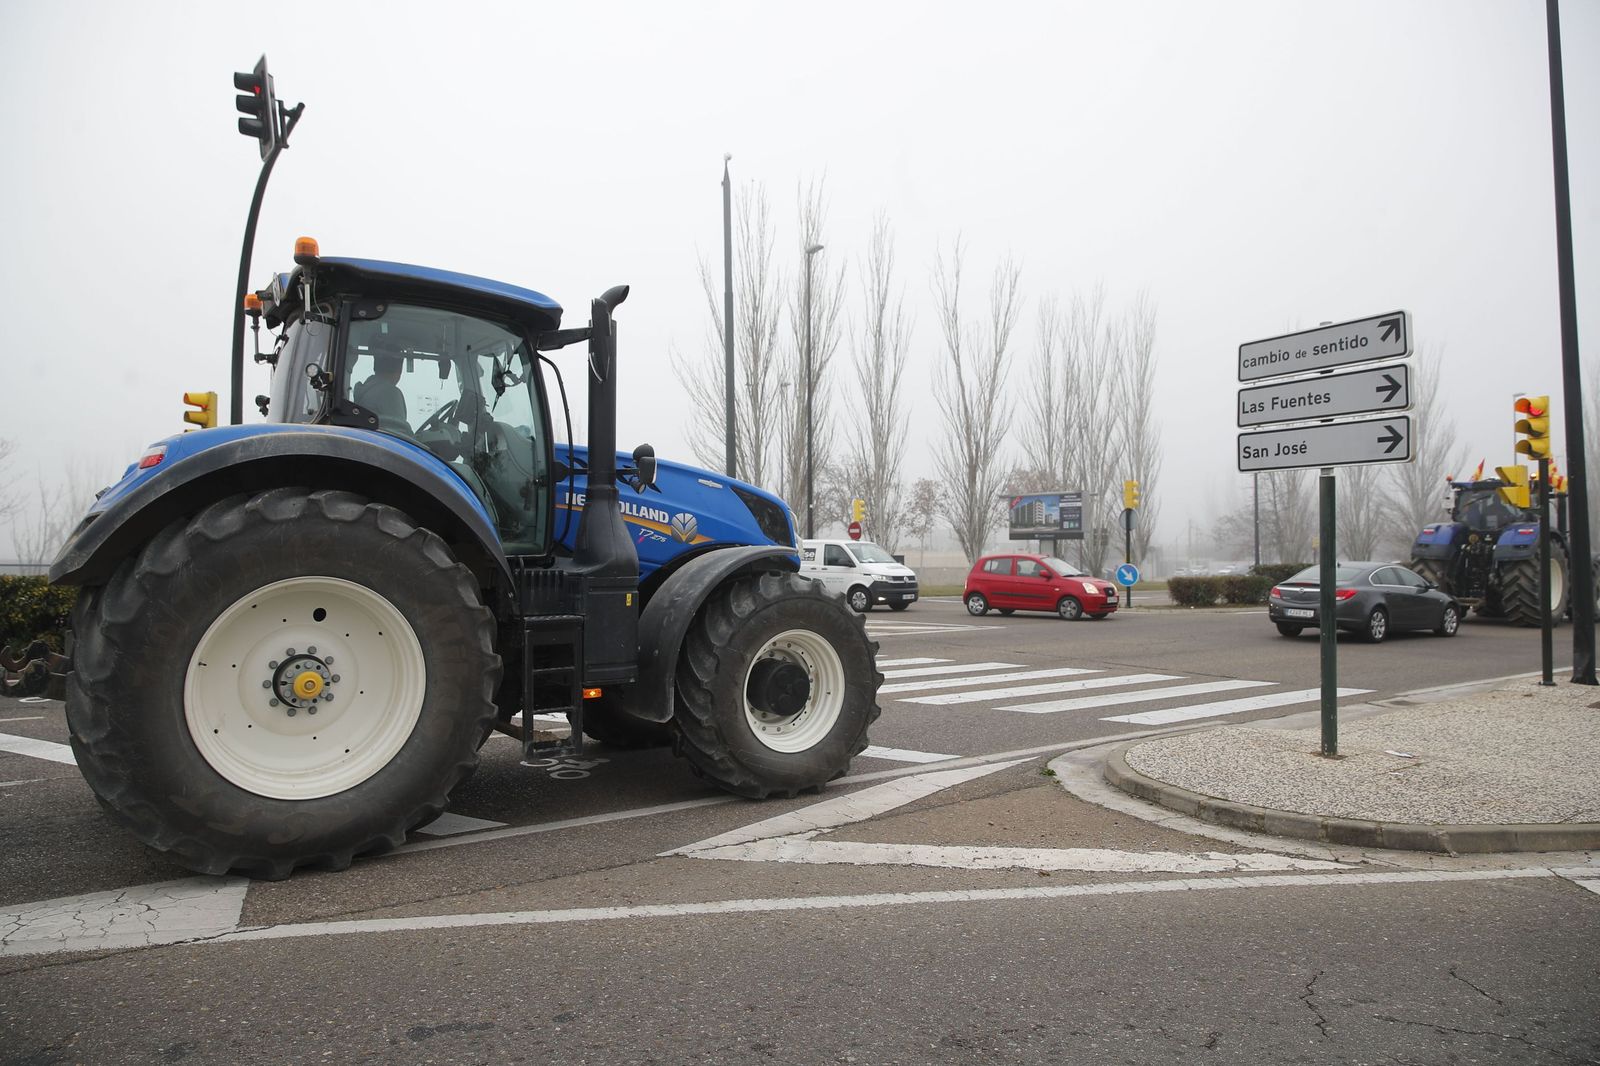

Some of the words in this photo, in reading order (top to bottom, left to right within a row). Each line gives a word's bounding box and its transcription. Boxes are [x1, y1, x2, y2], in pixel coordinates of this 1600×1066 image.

[1242, 350, 1290, 368] cambio
[1294, 349, 1307, 359] de
[1313, 334, 1369, 356] sentido
[1242, 401, 1265, 414] Las
[1271, 392, 1331, 411] Fuentes
[1242, 445, 1269, 459] San
[1274, 441, 1308, 456] José
[565, 492, 586, 506] NE
[618, 501, 669, 524] OLLAND
